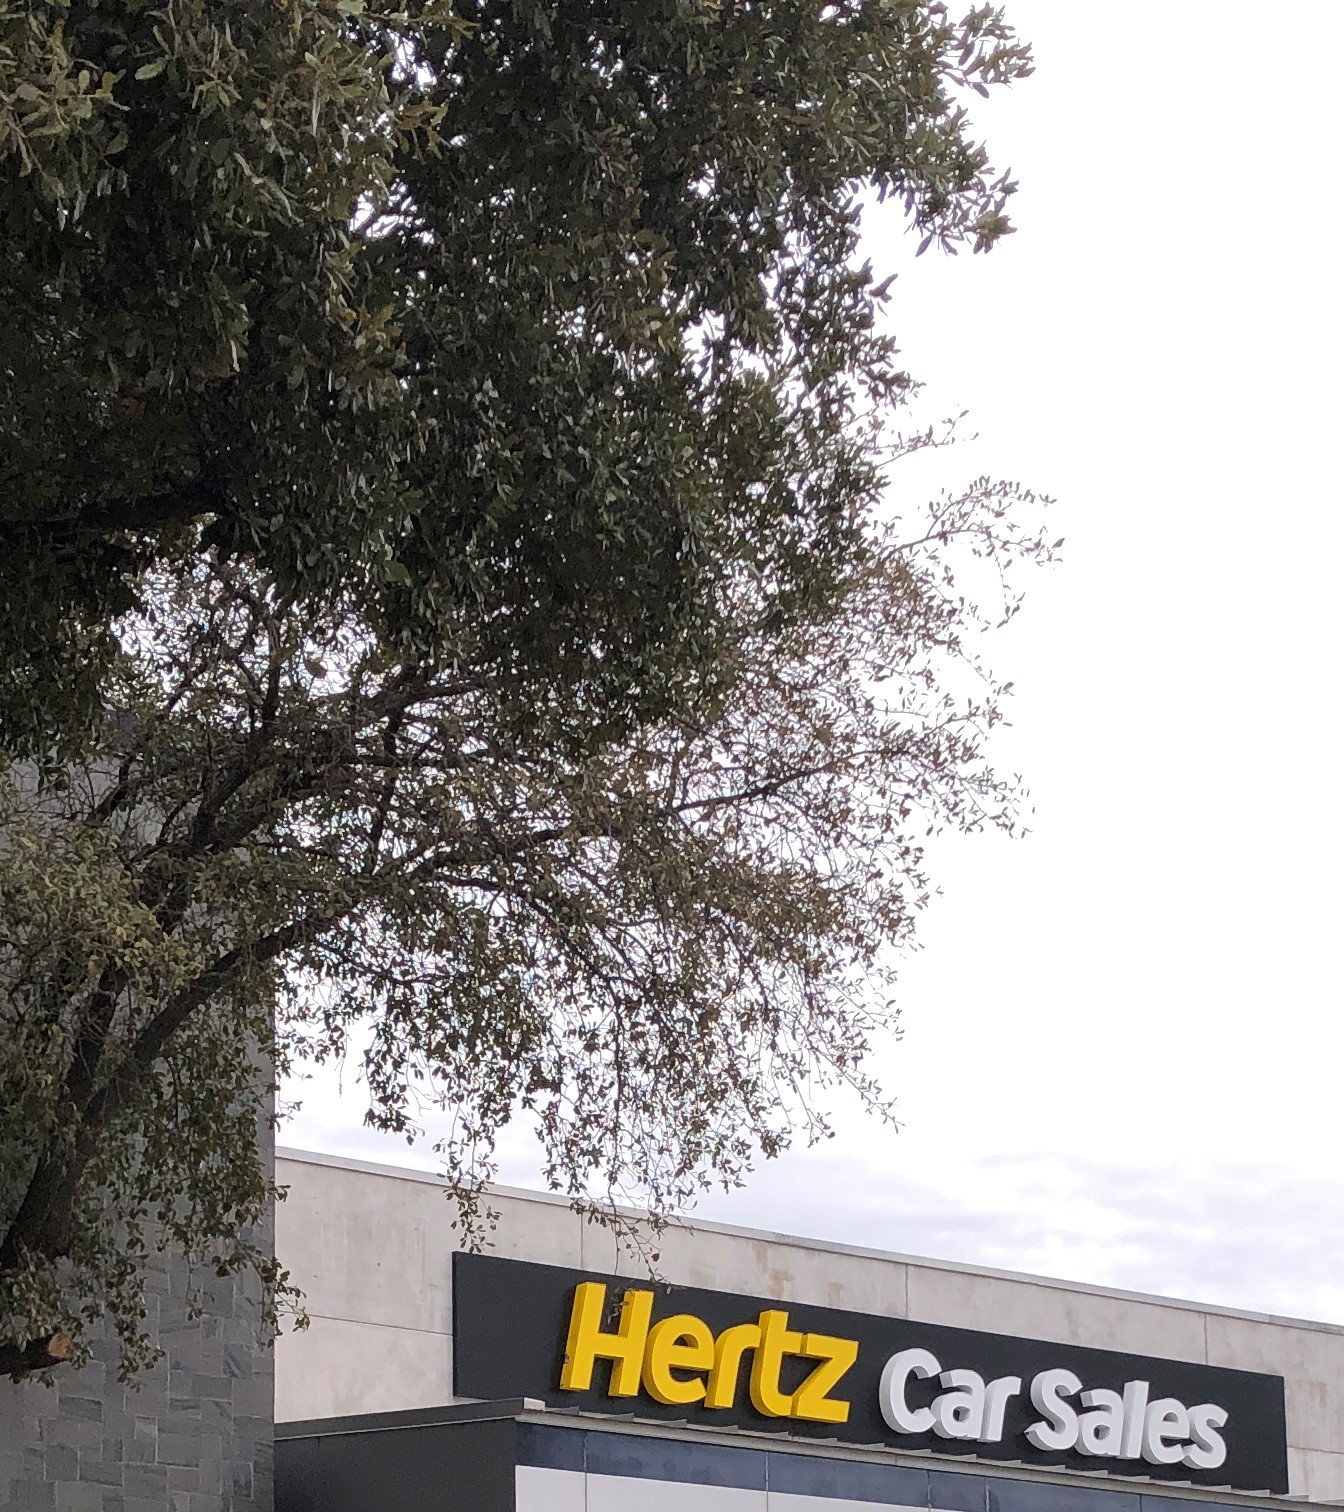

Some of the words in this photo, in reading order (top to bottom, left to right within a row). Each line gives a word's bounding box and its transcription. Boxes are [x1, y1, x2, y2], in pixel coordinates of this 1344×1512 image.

[560, 1281, 860, 1424] Hertz
[879, 1347, 1021, 1442] Car
[1024, 1368, 1229, 1469] Sales
